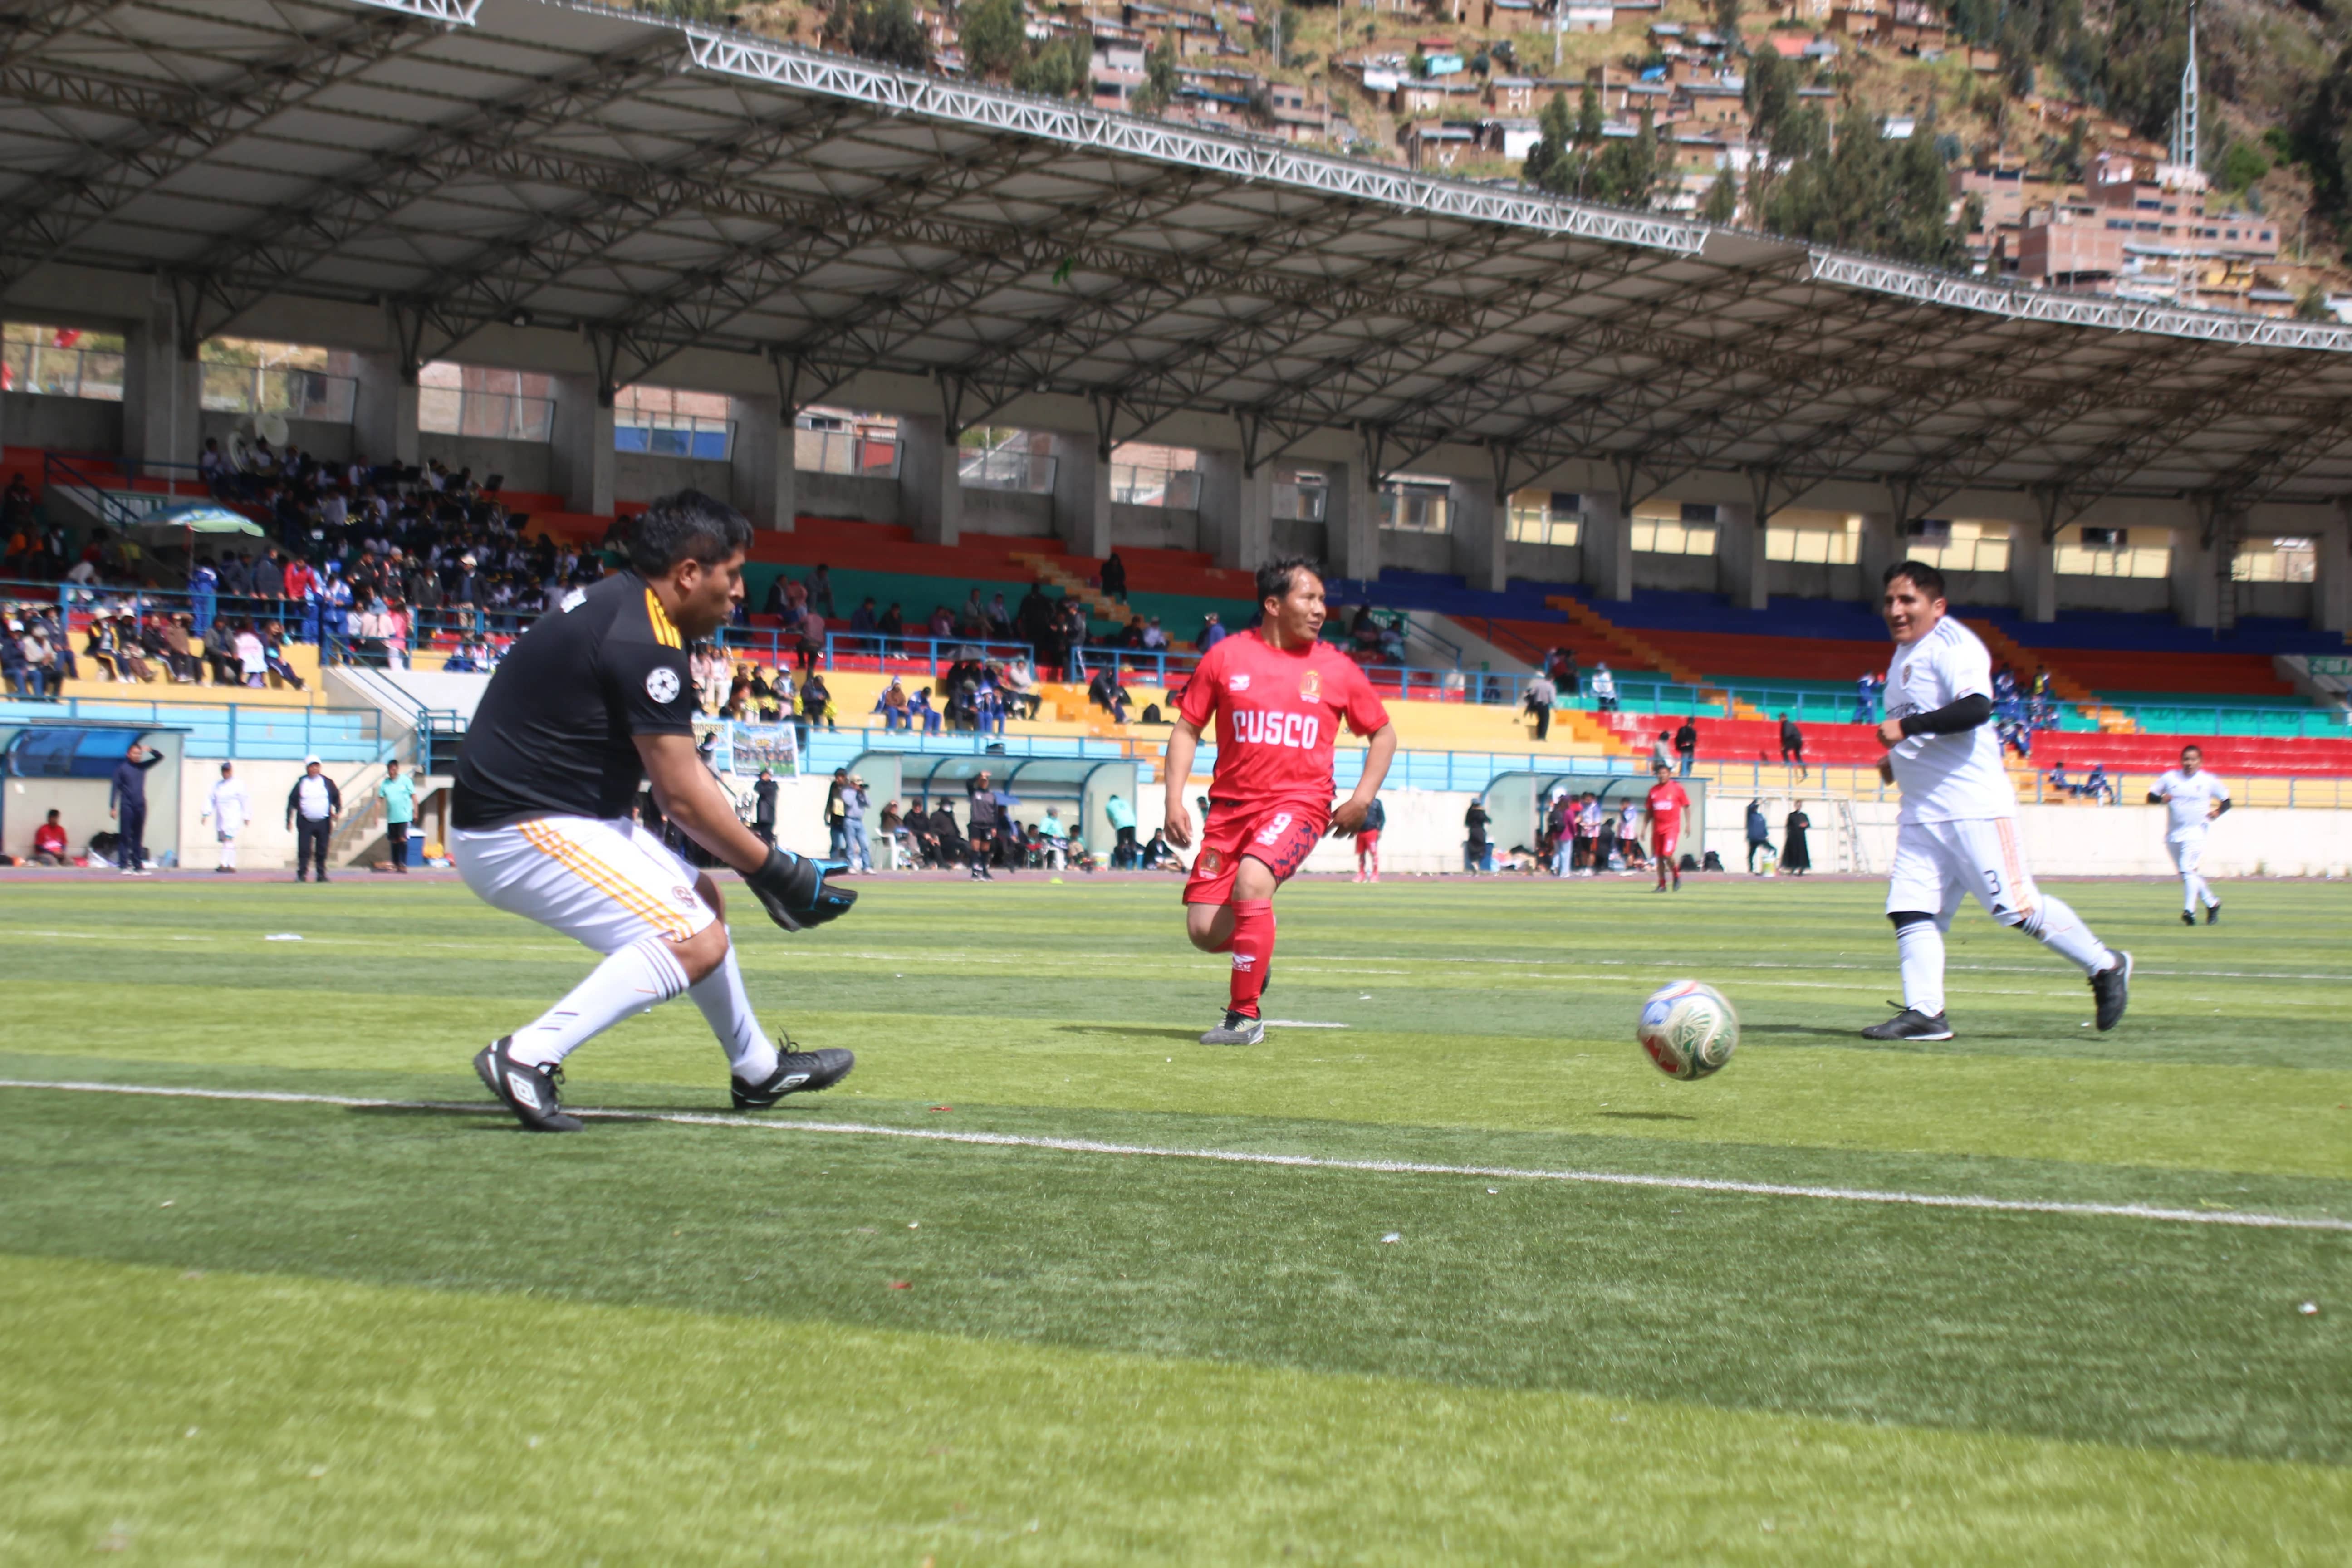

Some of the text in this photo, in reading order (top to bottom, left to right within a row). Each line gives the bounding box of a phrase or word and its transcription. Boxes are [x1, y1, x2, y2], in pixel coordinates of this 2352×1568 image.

[1232, 710, 1319, 750] CUSCO
[1269, 812, 1292, 834] 9
[1983, 870, 2002, 897] 3
